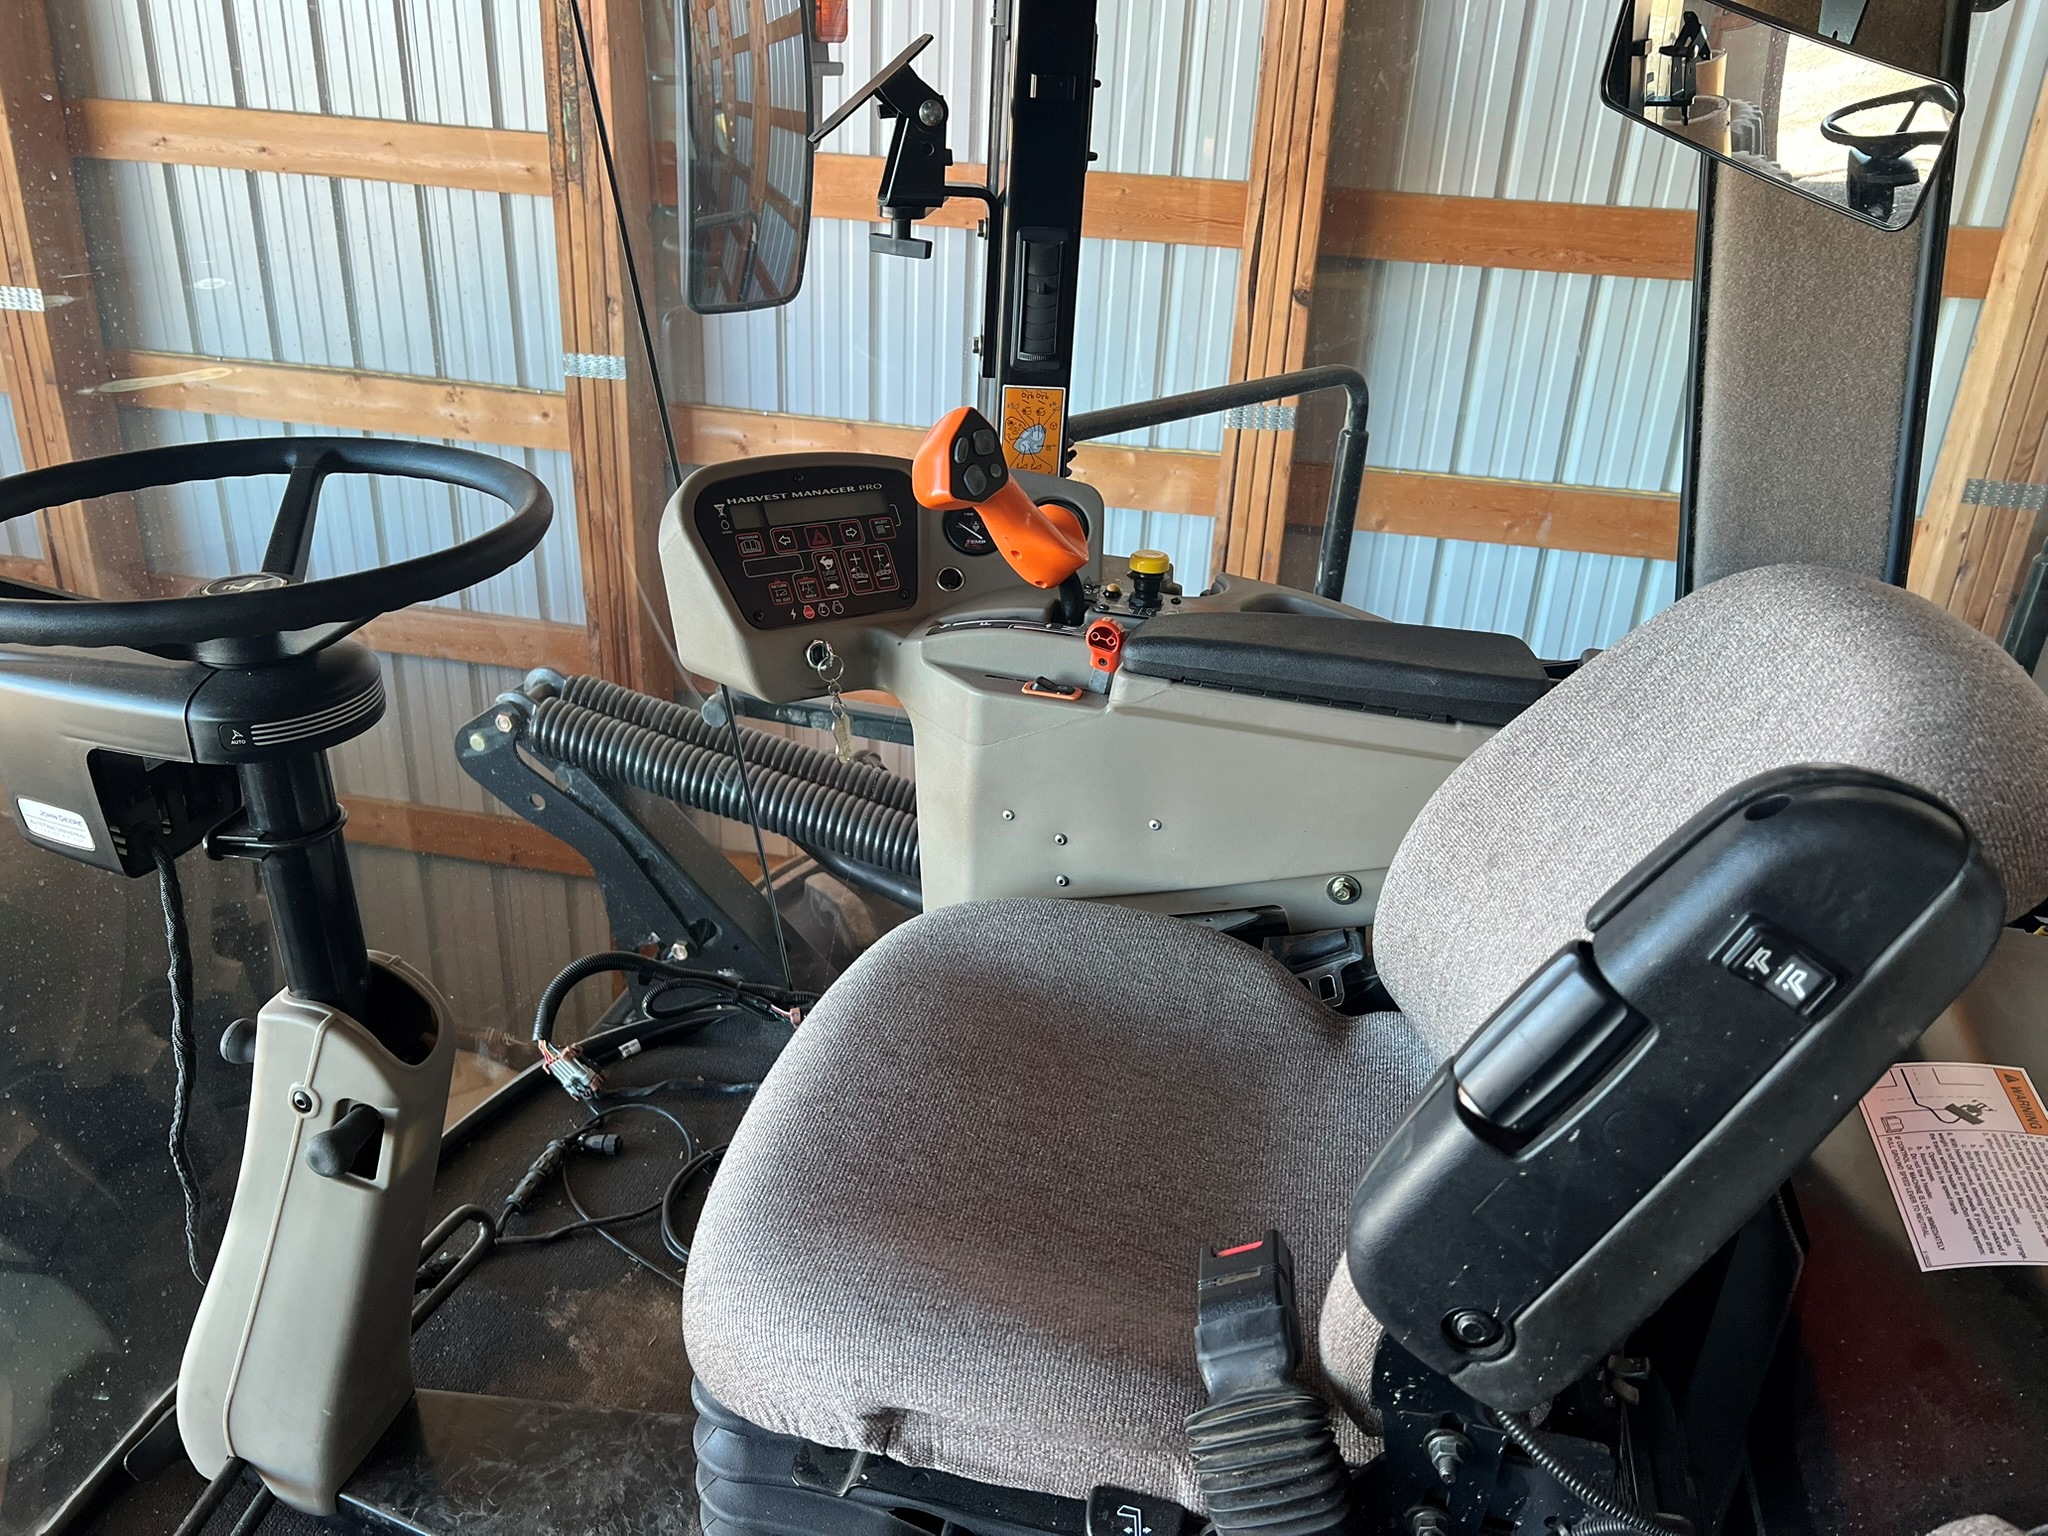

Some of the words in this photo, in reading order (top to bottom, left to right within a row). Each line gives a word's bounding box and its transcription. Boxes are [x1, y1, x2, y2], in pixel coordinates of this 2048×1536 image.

[726, 492, 787, 504] HARVEST
[792, 486, 856, 498] MANAGER
[858, 482, 882, 491] PRO
[40, 810, 58, 820] JOHN
[59, 815, 82, 827] DEERE
[2010, 1086, 2042, 1129] WARNING
[1885, 1137, 1896, 1148] PULL
[1935, 1132, 1949, 1147] weight
[1948, 1138, 1959, 1148] With
[1984, 1138, 1997, 1150] When
[2011, 1139, 2023, 1150] Limit
[1895, 1140, 1910, 1163] CONTROL
[1931, 1140, 1944, 1155] tractor
[1890, 1149, 1904, 1170] GROUND
[1918, 1152, 1930, 1164] Avoid
[1926, 1152, 1941, 1169] Operate
[1953, 1148, 1966, 1163] header
[1963, 1150, 1974, 1161] Shift
[1972, 1150, 1985, 1163] Move
[1981, 1150, 1996, 1167] Reduce
[1989, 1151, 2006, 1170] traveling
[2016, 1151, 2030, 1165] speed
[2026, 1156, 2041, 1170] rapidly
[1938, 1156, 1952, 1173] without
[1949, 1161, 1962, 1175] added
[1967, 1161, 1984, 1181] high-low
[1977, 1164, 1991, 1180] ground
[1898, 1170, 1911, 1186] SPEED
[1915, 1168, 1925, 1177] tow
[1923, 1166, 1936, 1182] slopes.
[1937, 1175, 1947, 1183] low
[1989, 1168, 2002, 1182] speed
[1998, 1133, 2012, 1147] towing
[2020, 1176, 2034, 1192] ensure
[2027, 1193, 2045, 1212] steering
[1907, 1171, 1923, 1194] MACHINE
[1945, 1173, 1959, 1190] header
[1958, 1181, 1969, 1193] drive
[1977, 1182, 1990, 1196] speed
[1985, 1180, 1998, 1195] speed
[1996, 1183, 2007, 1192] and
[2002, 1178, 2015, 1191] steep
[2026, 1171, 2046, 1194] maximum
[1905, 1187, 1918, 1204] LEVER
[1941, 1185, 1953, 1199] speed
[1969, 1187, 1985, 1206] steering
[2001, 1155, 2016, 1171] manual
[2012, 1180, 2028, 1196] adding
[2020, 1197, 2036, 1213] weight
[2033, 1220, 2046, 1232] drive
[2001, 1193, 2014, 1206] lower
[1919, 1200, 1932, 1215] LOST,
[1946, 1200, 1959, 1215] range.
[1956, 1197, 1971, 1217] MacDon
[1964, 1194, 1978, 1211] wheels.
[1984, 1198, 1999, 1214] control
[1973, 1217, 1984, 1227] you
[1978, 1207, 1993, 1224] control
[2001, 1214, 2014, 1226] slow
[1914, 1212, 1931, 1238] NEUTRAL.
[1963, 1218, 1979, 1234] weight
[1995, 1221, 2006, 1230] low
[2007, 1227, 2018, 1237] end
[1925, 1216, 1946, 1250] IMMEDIATELY
[1978, 1227, 1990, 1240] must
[1989, 1230, 2005, 1250] reduced
[1998, 1231, 2013, 1246] range.
[1971, 1235, 1988, 1255] system:
[1984, 1241, 1996, 1254] drive
[2013, 1244, 2029, 1260] range.
